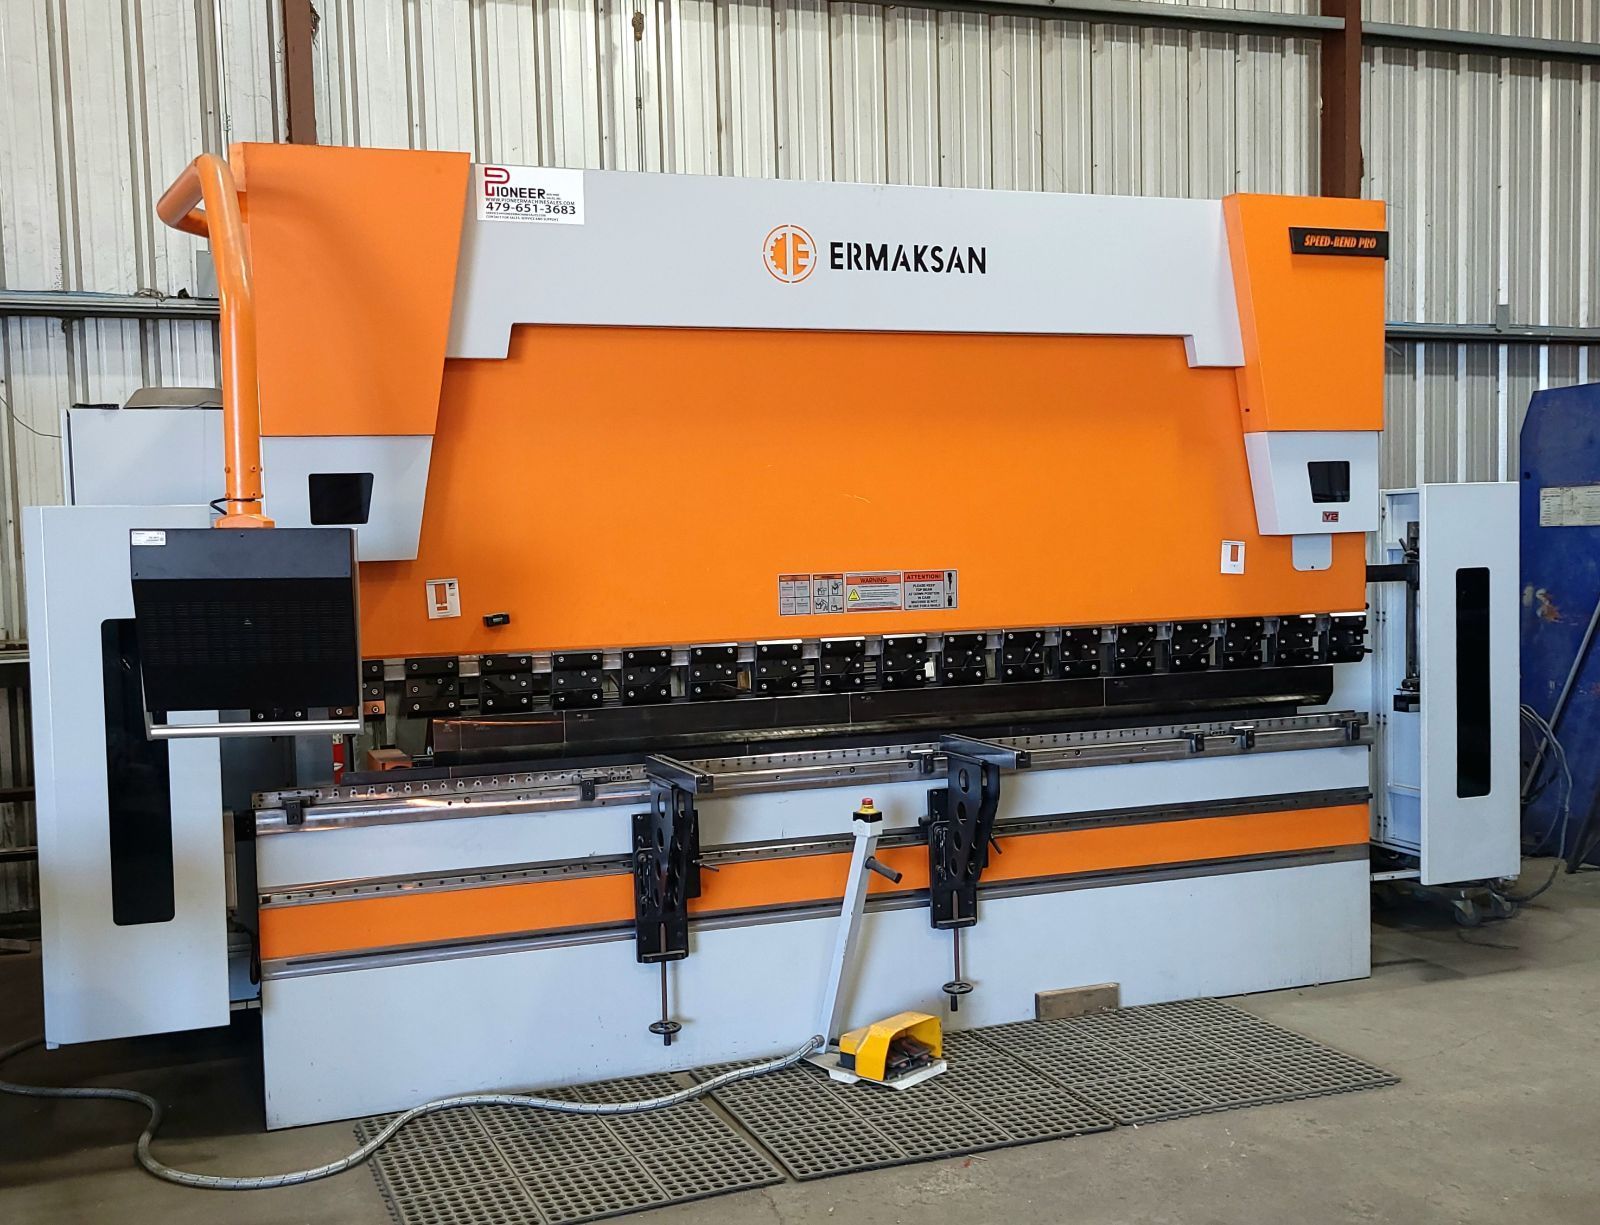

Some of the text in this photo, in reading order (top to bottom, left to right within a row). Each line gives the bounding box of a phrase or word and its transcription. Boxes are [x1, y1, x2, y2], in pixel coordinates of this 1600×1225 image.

[484, 167, 546, 199] PIONEER
[486, 202, 576, 215] 479-651-3683
[1358, 236, 1377, 249] PRO
[830, 241, 986, 274] ERMAKSAN
[1324, 512, 1338, 522] Y2
